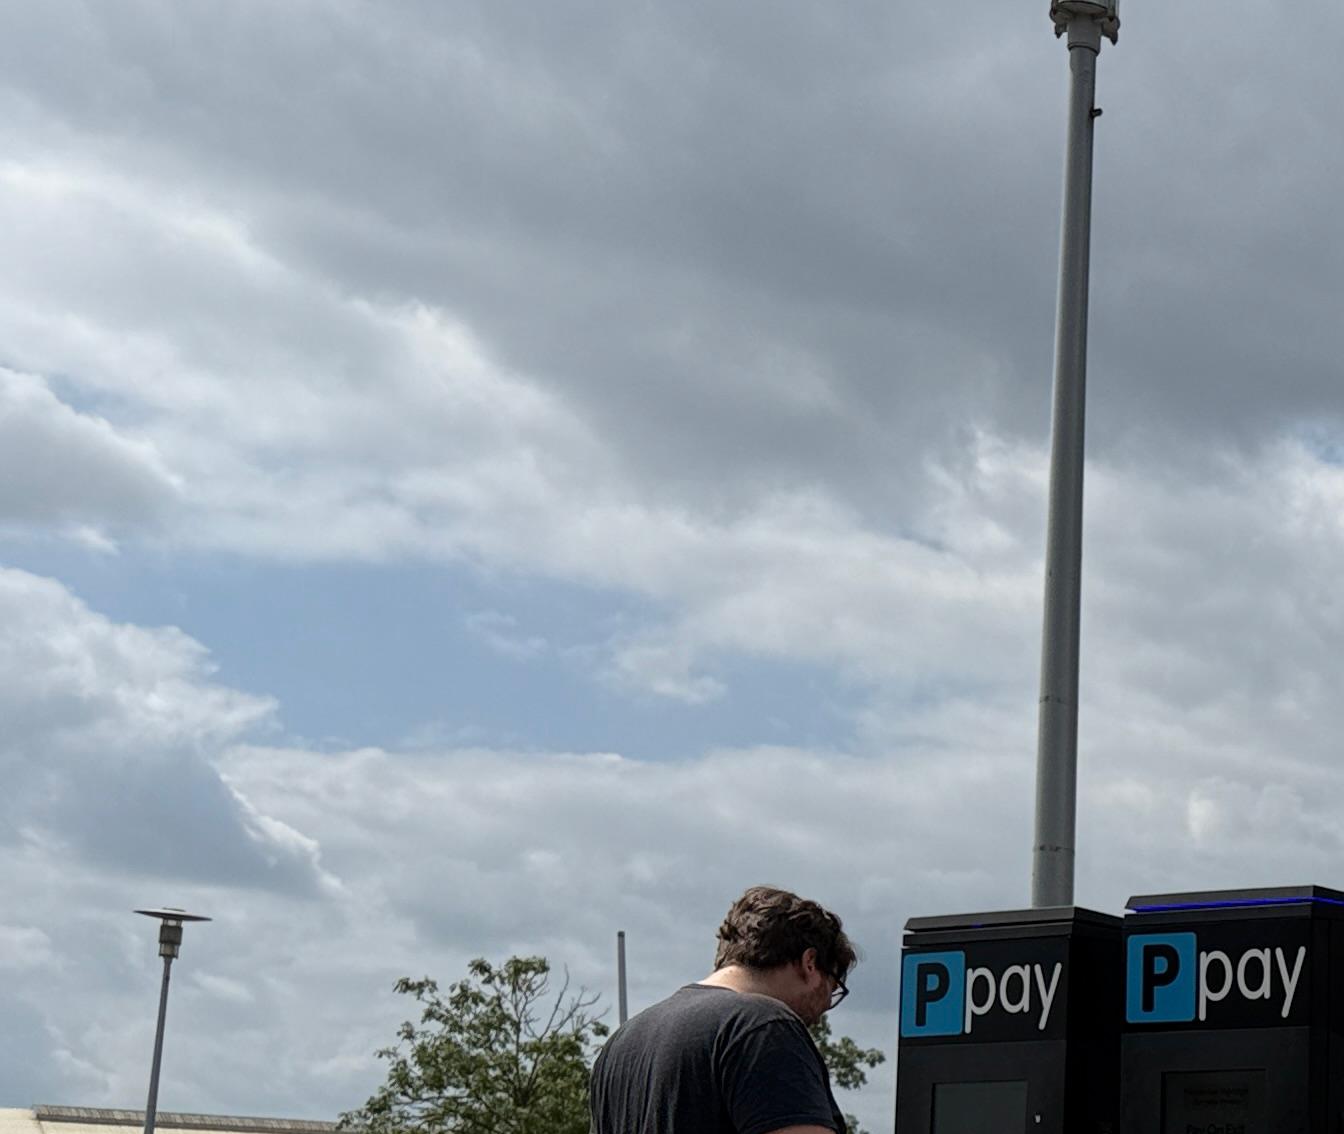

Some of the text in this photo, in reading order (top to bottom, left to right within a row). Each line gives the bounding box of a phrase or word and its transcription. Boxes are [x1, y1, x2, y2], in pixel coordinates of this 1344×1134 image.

[915, 962, 1063, 1034] P pay
[1142, 943, 1306, 1021] P pay
